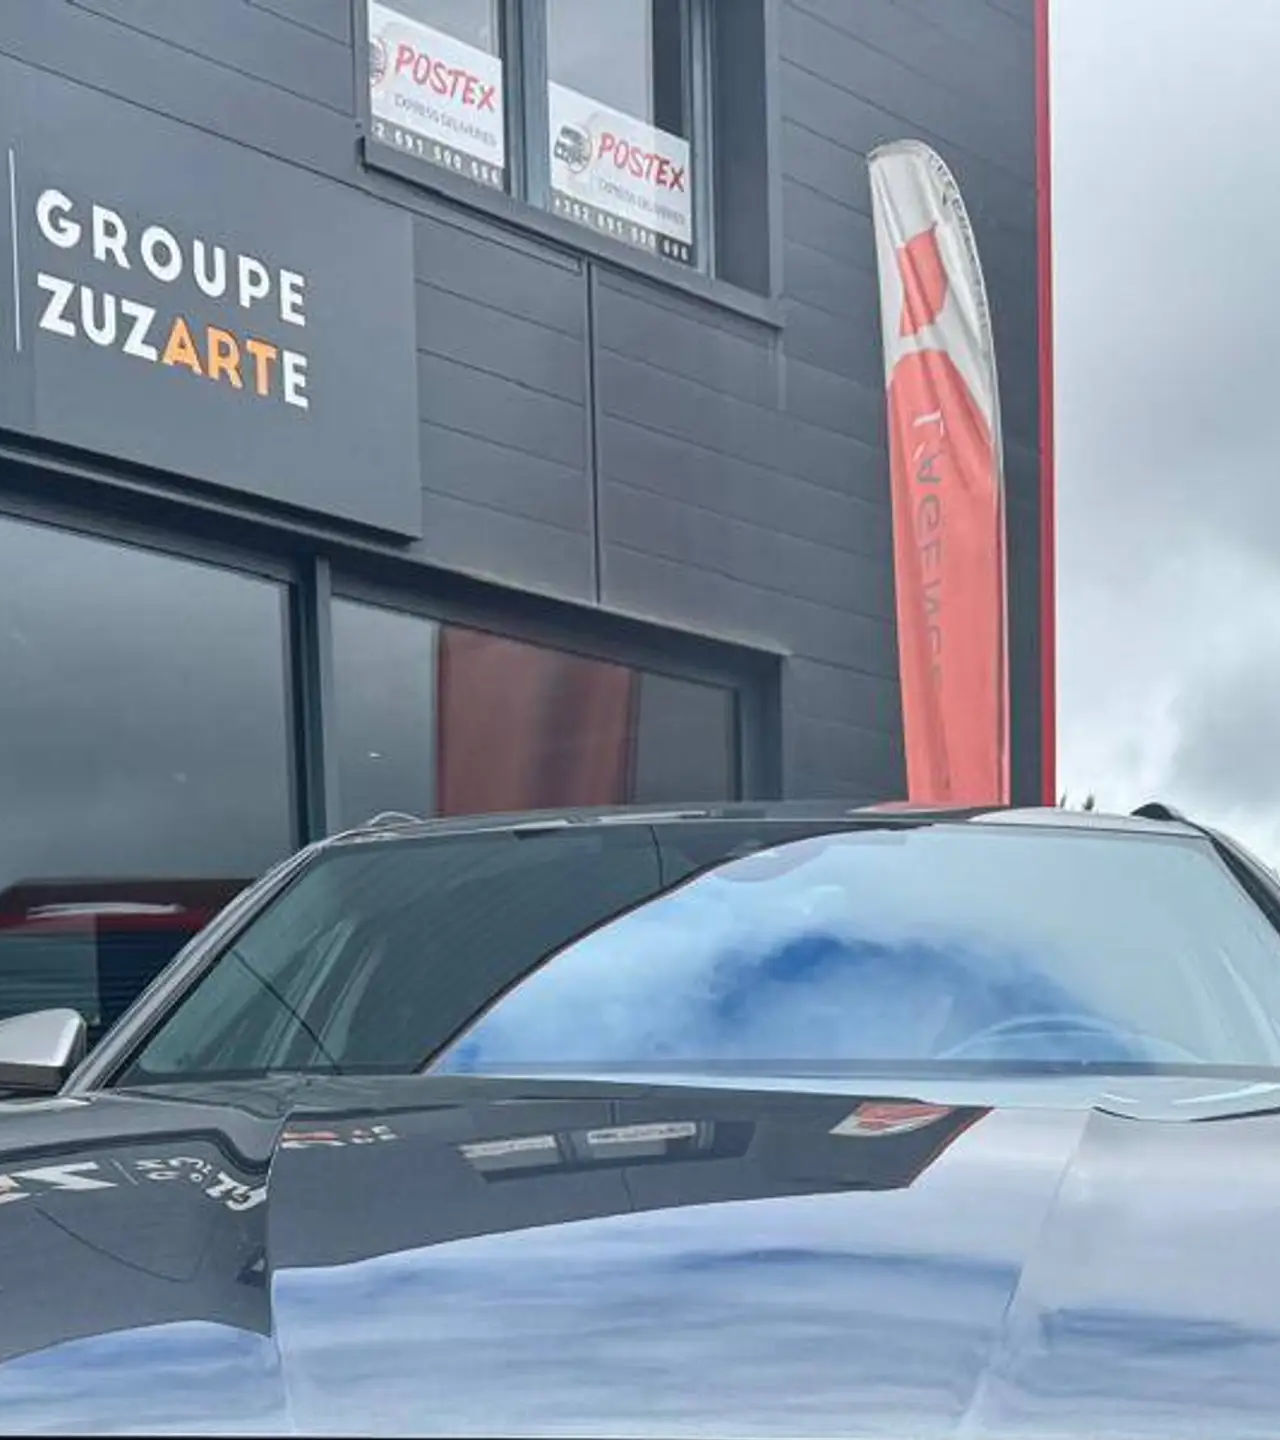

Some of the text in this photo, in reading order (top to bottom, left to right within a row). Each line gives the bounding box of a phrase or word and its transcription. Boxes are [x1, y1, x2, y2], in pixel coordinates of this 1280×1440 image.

[395, 43, 496, 115] POSTEX
[598, 131, 686, 194] POSTEX
[35, 188, 307, 327] GROUPE
[36, 271, 310, 410] ZUZARTE
